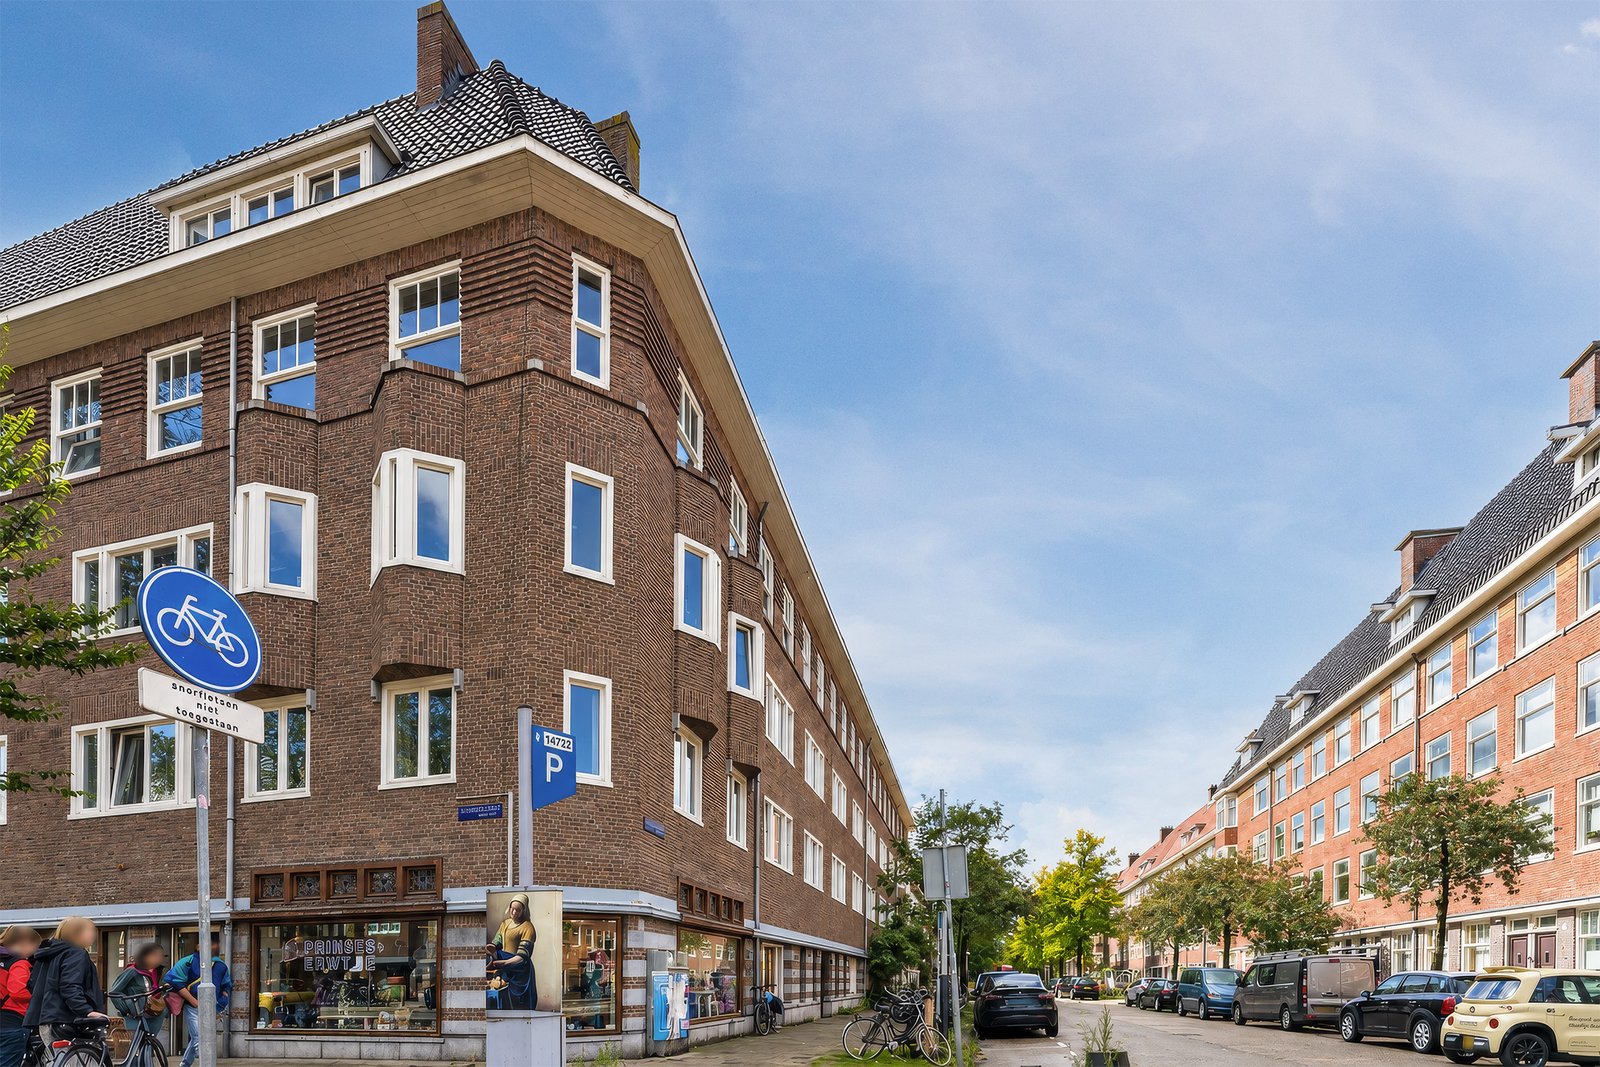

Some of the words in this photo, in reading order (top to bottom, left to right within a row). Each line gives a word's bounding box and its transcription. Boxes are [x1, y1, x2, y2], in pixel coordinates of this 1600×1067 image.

[171, 682, 239, 710] snorfietsen
[196, 702, 219, 715] niet
[175, 706, 239, 733] toegestaan
[545, 735, 572, 750] 14722
[546, 751, 563, 783] P
[303, 938, 376, 955] PRINSES
[303, 954, 376, 972] ERWTJE
